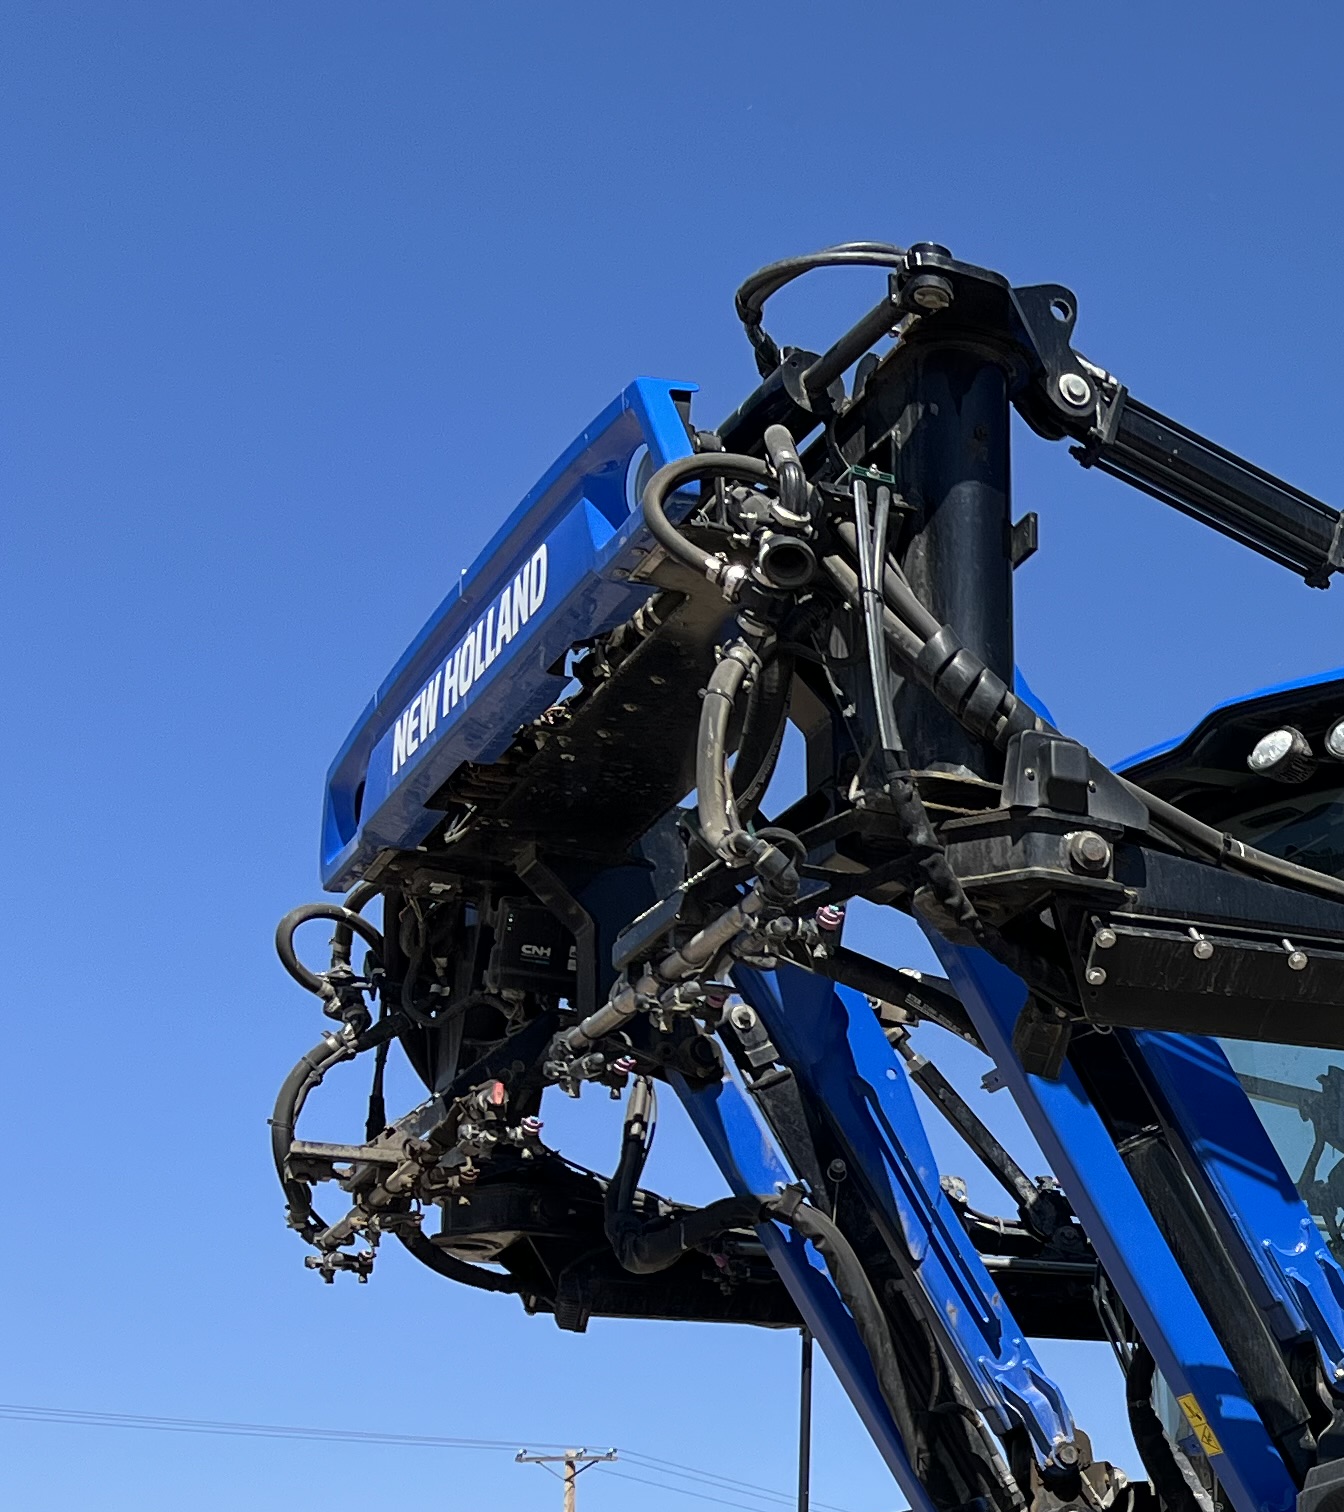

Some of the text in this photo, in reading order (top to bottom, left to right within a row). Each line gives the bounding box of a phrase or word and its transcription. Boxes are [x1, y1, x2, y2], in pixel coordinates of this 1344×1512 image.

[391, 543, 548, 776] NEW HOLLAND
[521, 944, 551, 957] CNH
